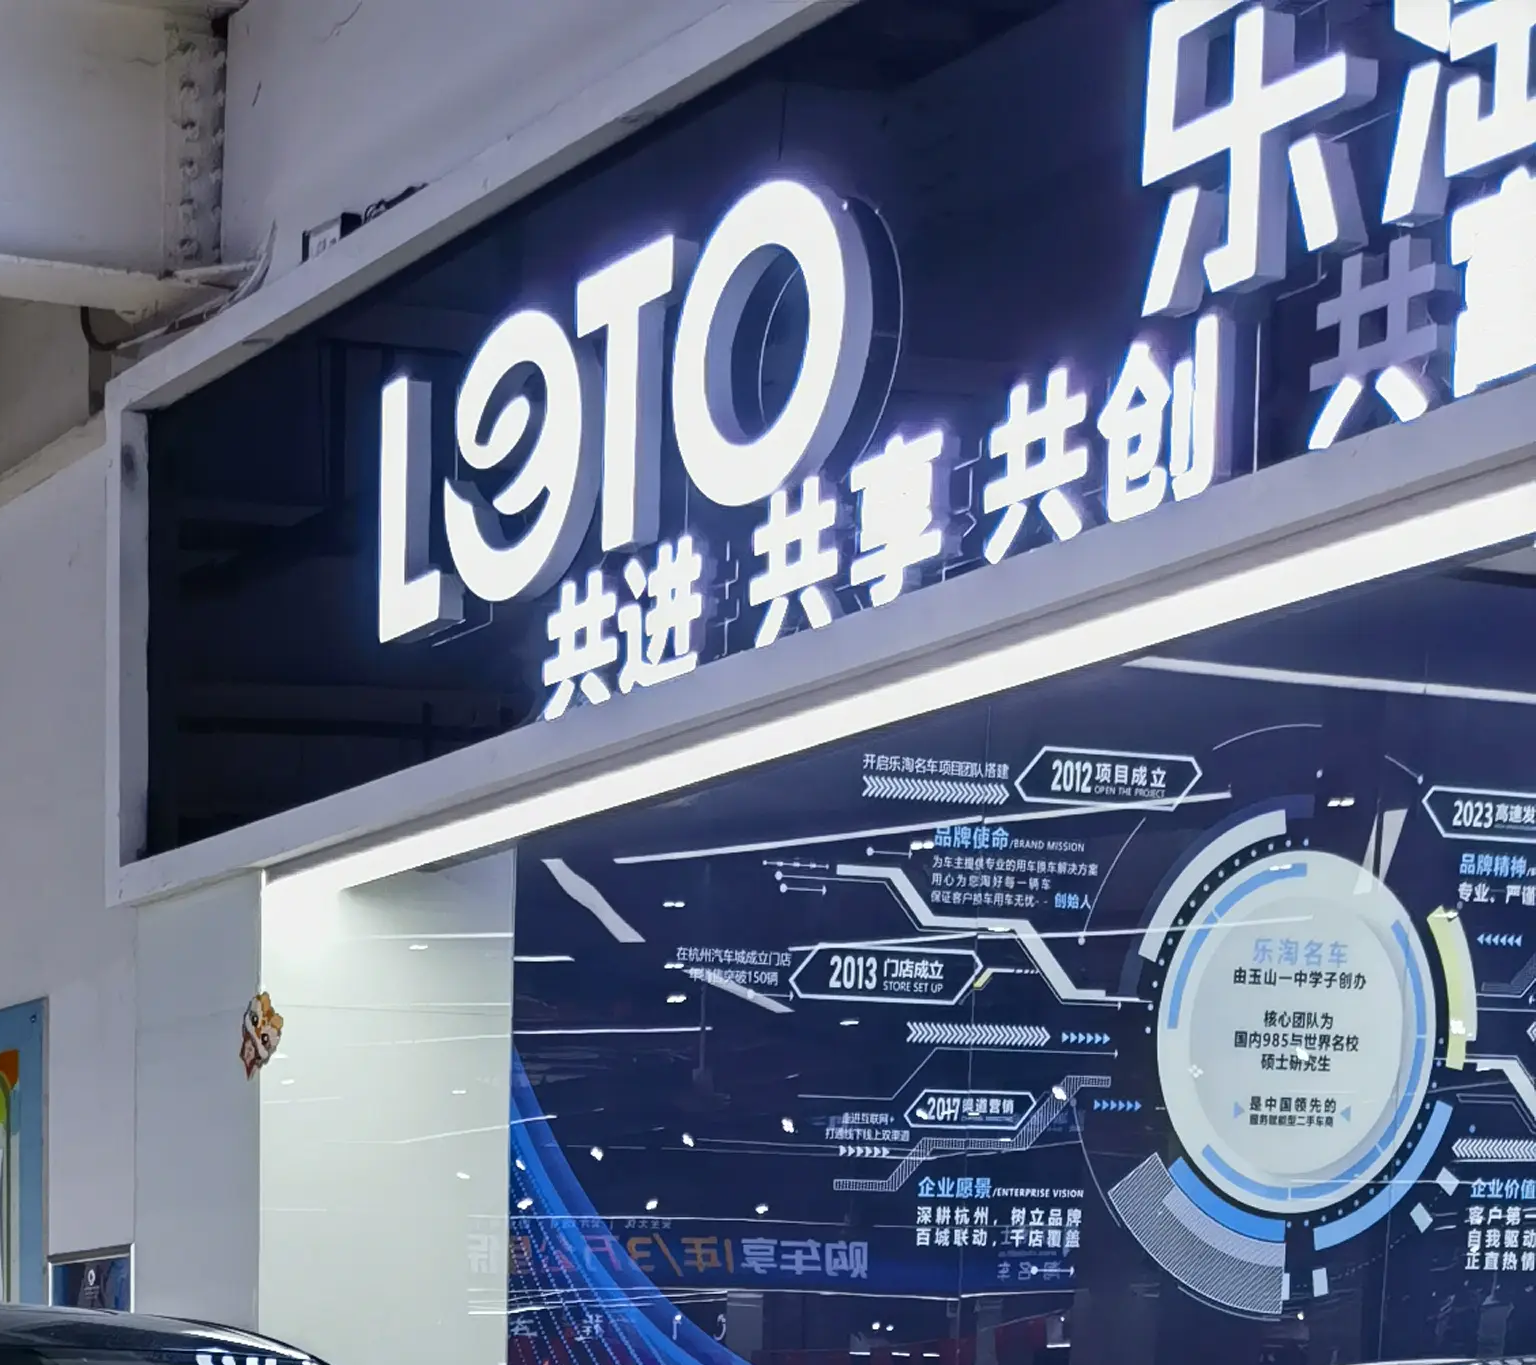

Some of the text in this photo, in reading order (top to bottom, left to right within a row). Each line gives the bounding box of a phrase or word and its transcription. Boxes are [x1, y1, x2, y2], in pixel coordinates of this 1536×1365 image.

[379, 180, 849, 643] LOTO
[544, 534, 703, 720] 共进
[749, 427, 945, 649] 共享
[983, 311, 1220, 566] 共创
[1051, 760, 1167, 794] 2012 项目成立
[1452, 799, 1494, 828] 2023
[933, 826, 1009, 850] 品牌使命
[1047, 840, 1085, 852] MISSION
[1459, 853, 1527, 879] 品牌精神
[1054, 893, 1093, 911] 创始人
[675, 946, 792, 967] 在杭州汽车城成立门店
[1252, 937, 1349, 968] 乐淘名车
[828, 955, 945, 990] 2013 门店成立
[1232, 966, 1367, 990] 由玉山一中学子创办
[882, 980, 944, 993] STORE SET UP
[1263, 1010, 1334, 1030] 核心团队为
[1233, 1031, 1359, 1052] 国内985与世界名校
[1260, 1053, 1331, 1072] 硕士研究生
[927, 1096, 961, 1121] 2017
[1249, 1096, 1337, 1114] 是中国领先的
[917, 1176, 992, 1199] 企业愿景
[1052, 1187, 1085, 1199] VISION
[1470, 1177, 1536, 1200] 企业价值
